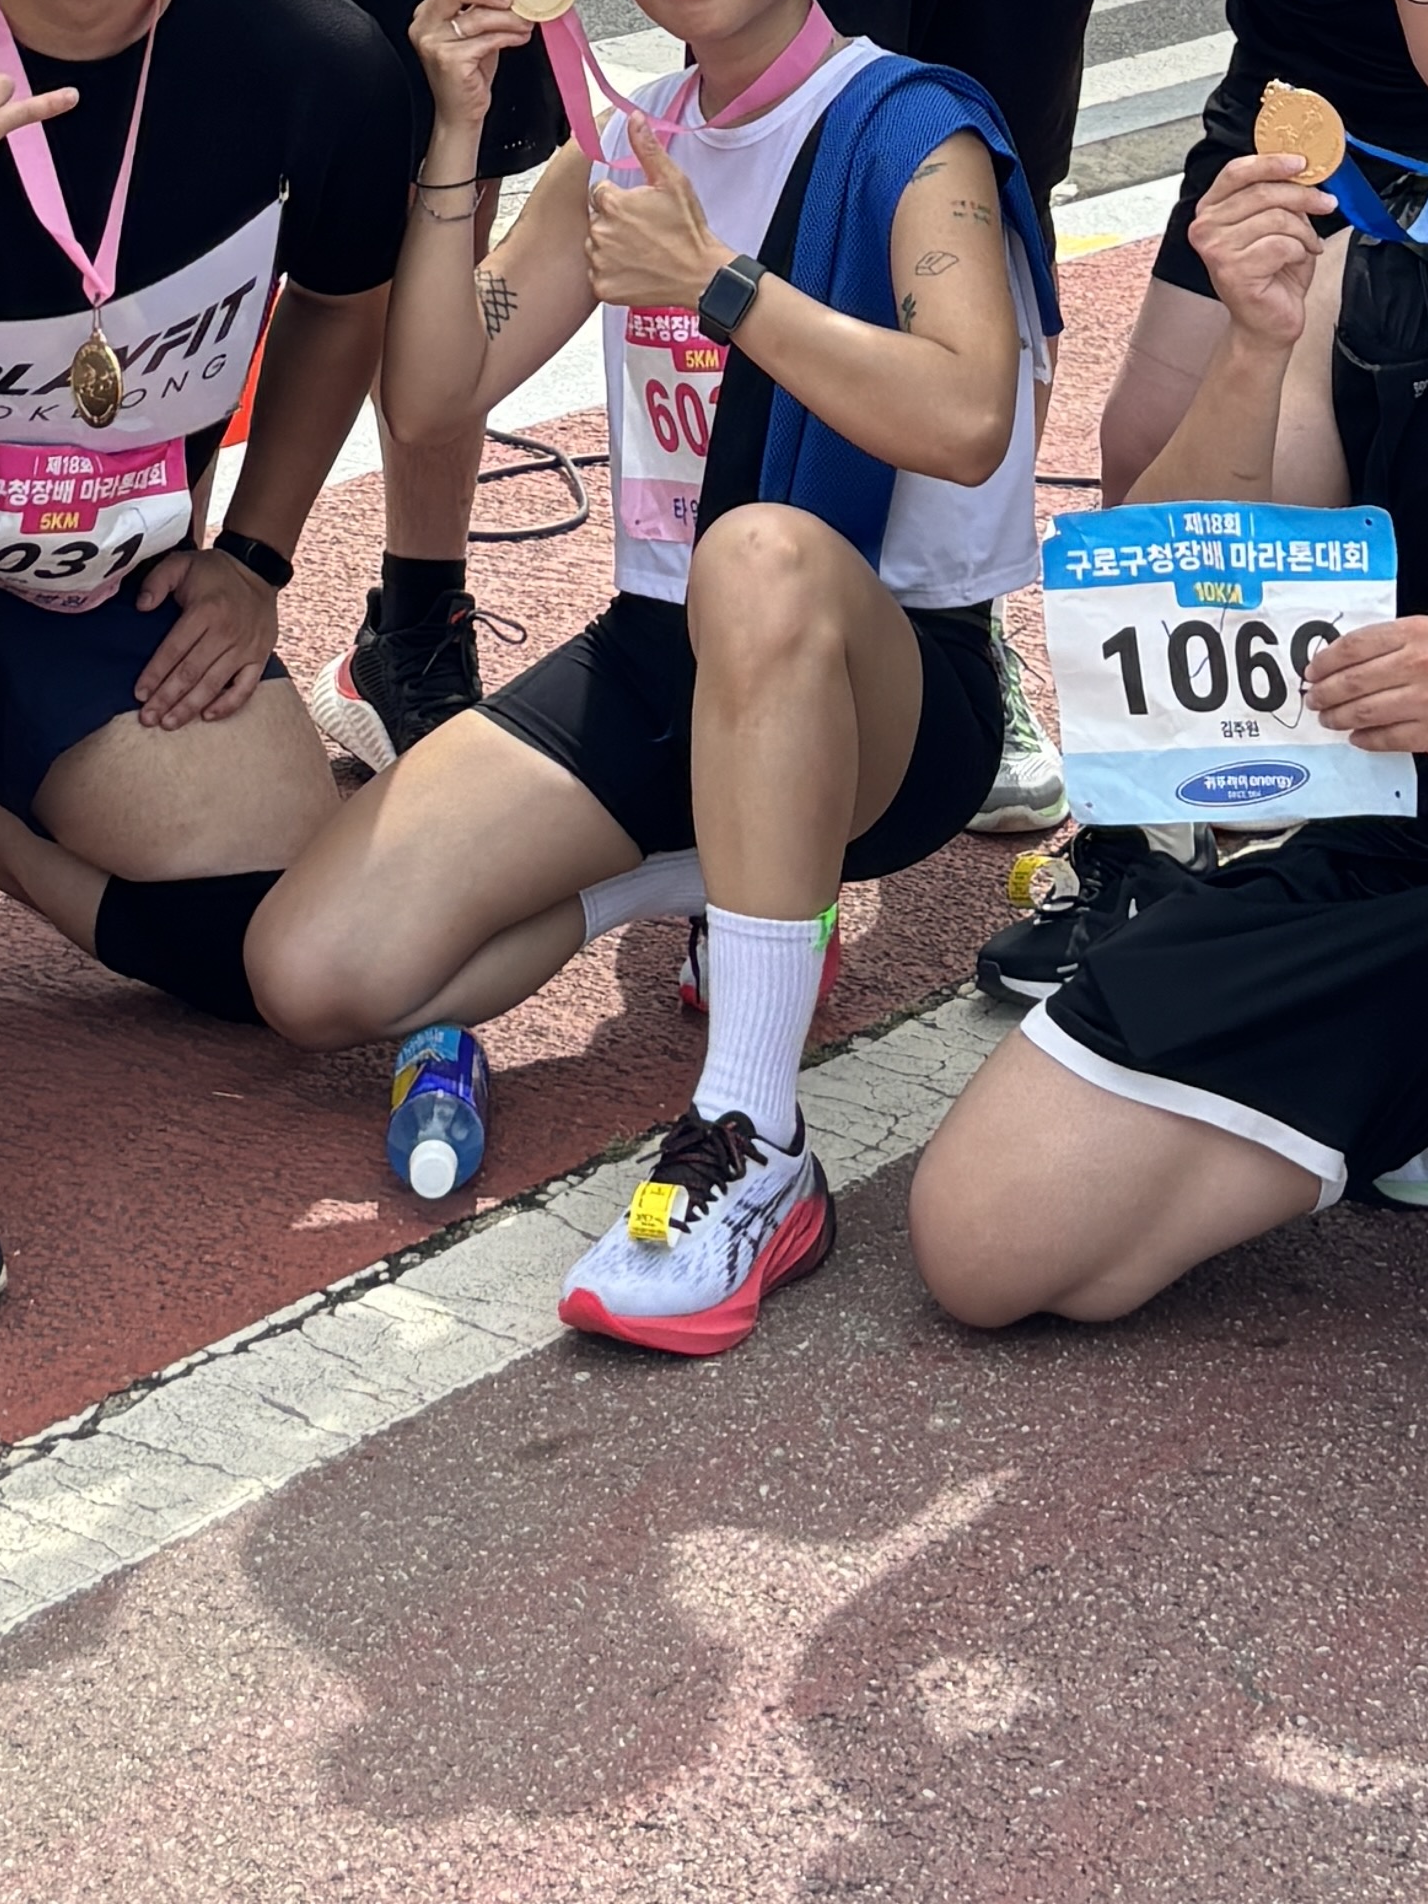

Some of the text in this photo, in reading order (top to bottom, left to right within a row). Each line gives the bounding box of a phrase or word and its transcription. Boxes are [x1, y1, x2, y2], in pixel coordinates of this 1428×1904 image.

[684, 348, 721, 369] 5KM
[644, 378, 721, 459] 60
[44, 454, 95, 476] 제18회
[79, 459, 170, 504] 마라톤대회
[39, 511, 81, 531] 5KM
[1183, 511, 1242, 538] 제18회
[1065, 539, 1369, 581] 구로구청장배 마라톤대회
[1193, 582, 1244, 606] 10KM
